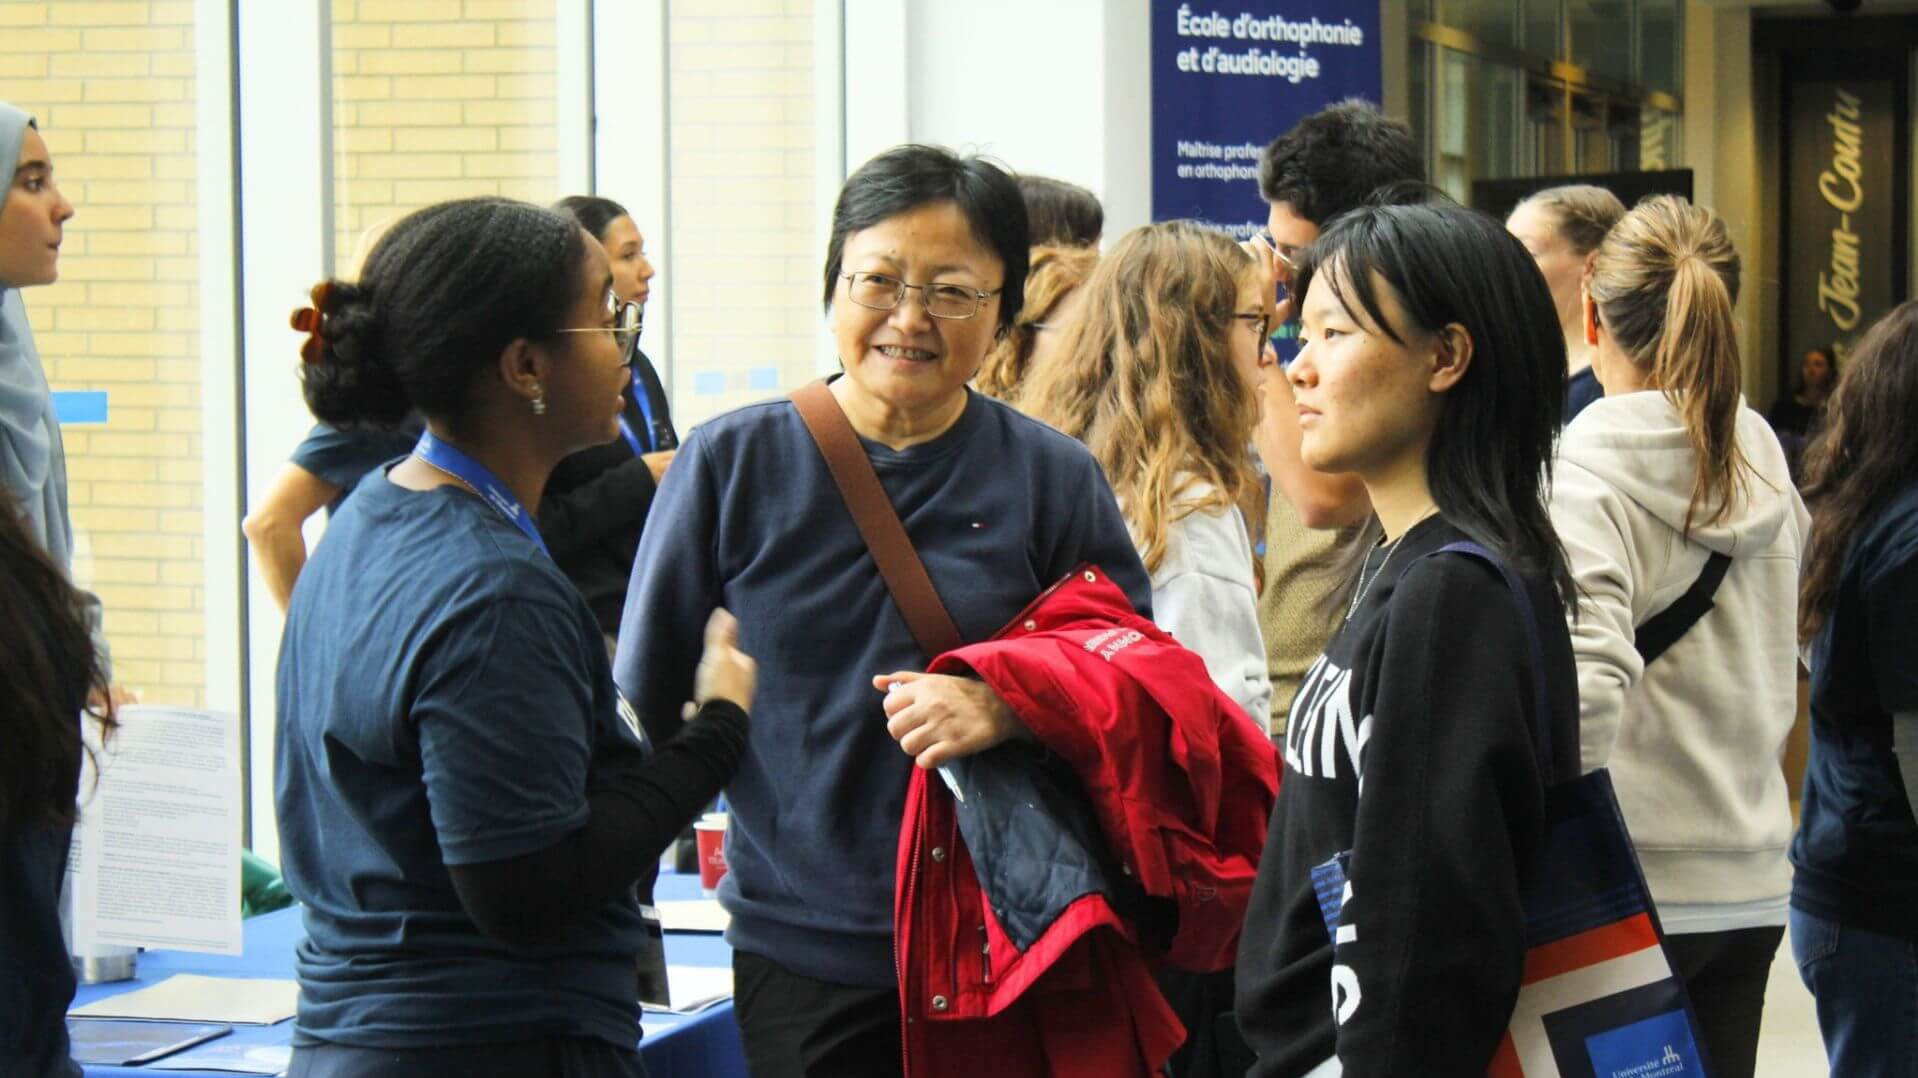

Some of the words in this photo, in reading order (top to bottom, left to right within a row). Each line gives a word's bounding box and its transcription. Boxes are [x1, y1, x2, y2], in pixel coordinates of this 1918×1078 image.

[1177, 3, 1230, 38] École
[1233, 12, 1363, 48] d'orthophonie
[1176, 47, 1200, 72] et
[1201, 46, 1320, 83] d'audiologie
[1177, 164, 1193, 178] en
